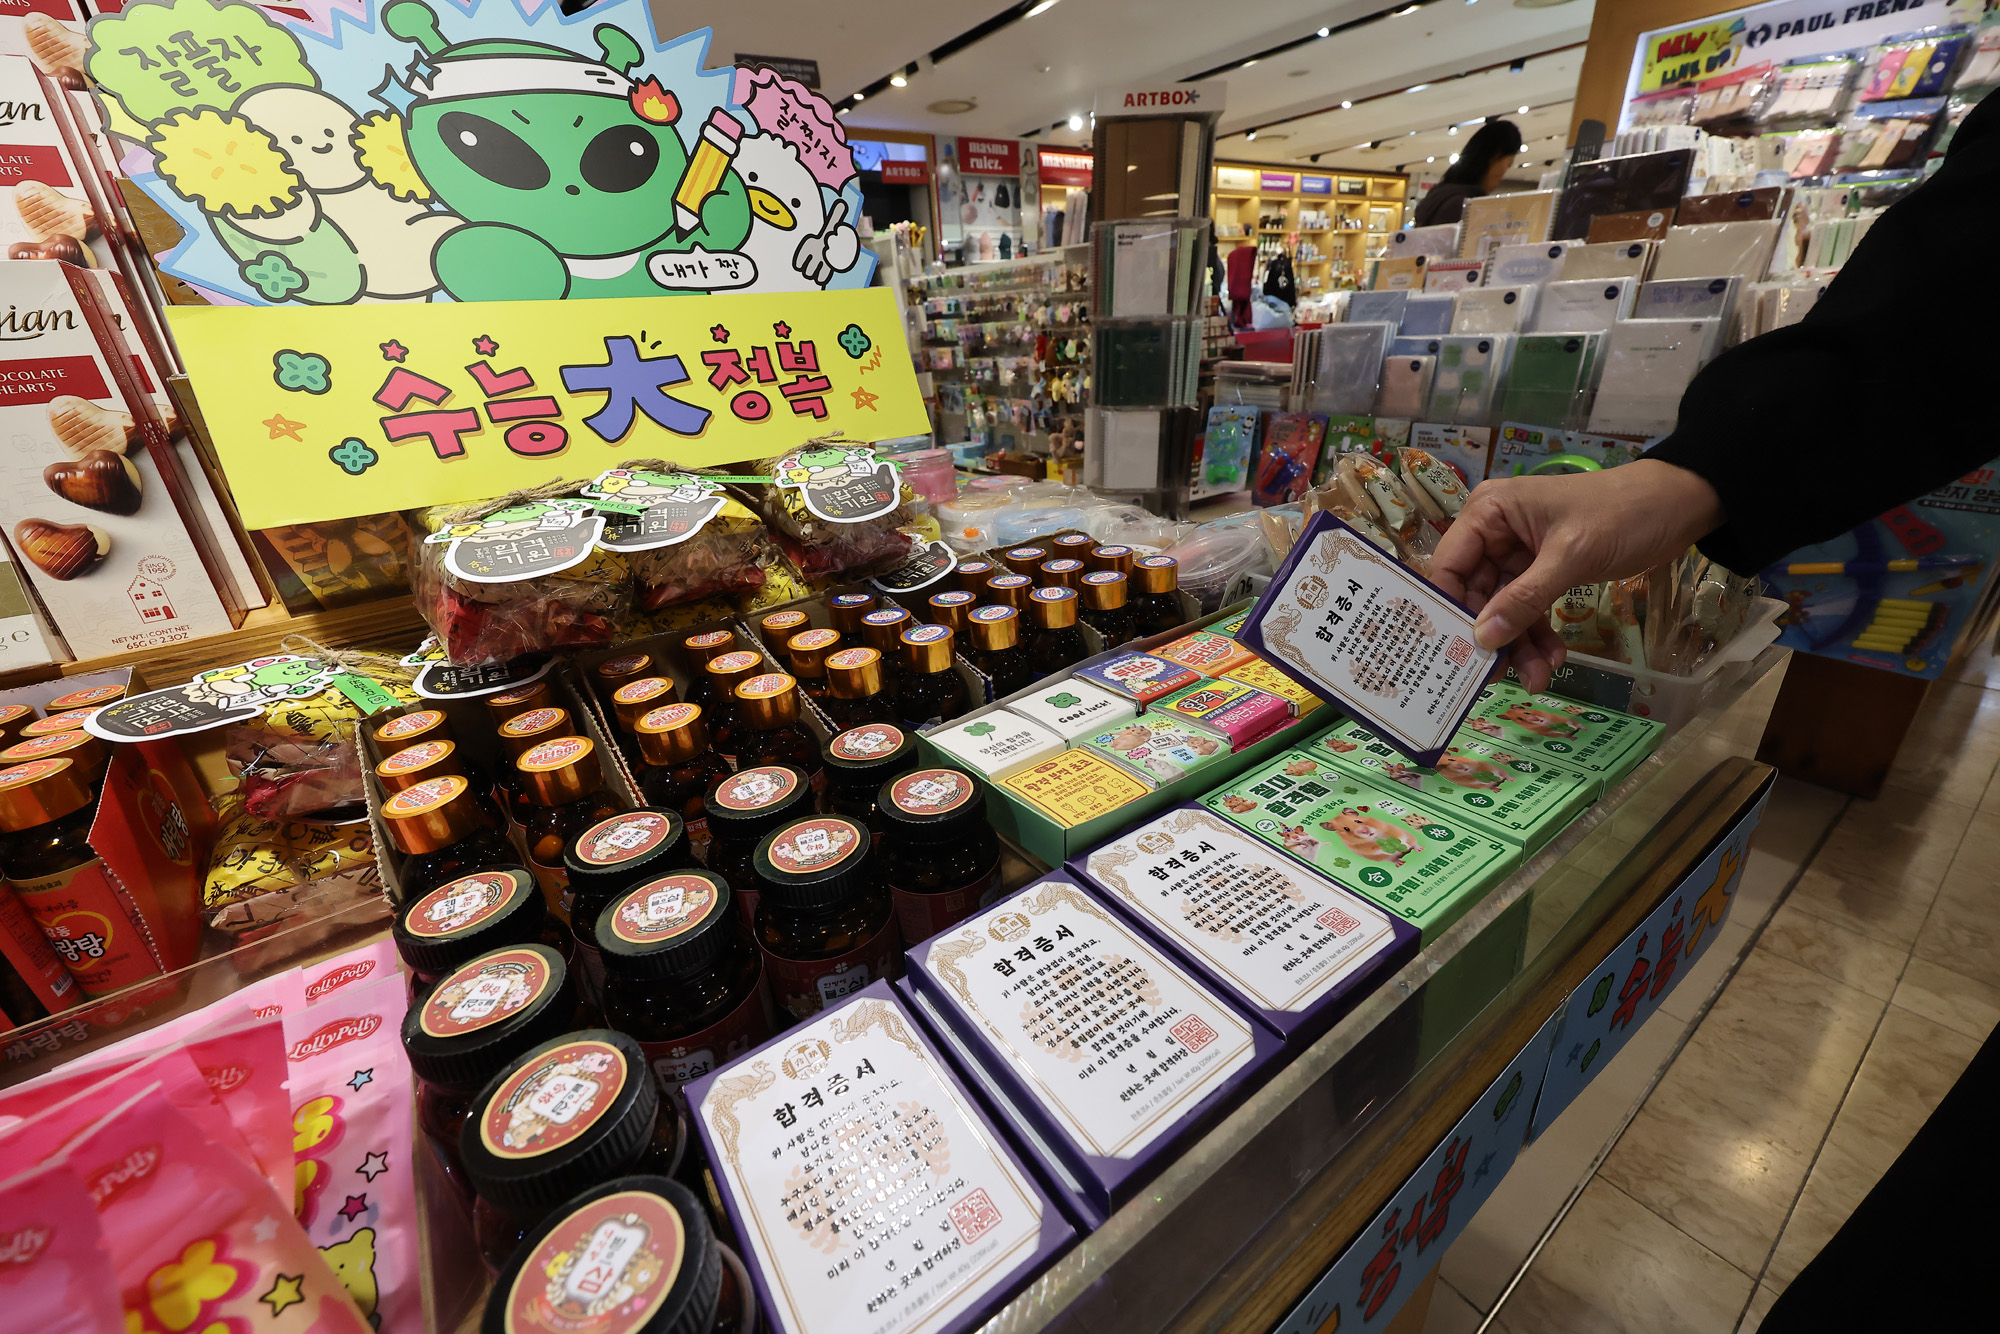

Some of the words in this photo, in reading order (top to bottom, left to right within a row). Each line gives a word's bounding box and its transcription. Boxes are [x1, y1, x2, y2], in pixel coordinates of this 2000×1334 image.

[1775, 12, 1836, 39] PAUL
[118, 29, 262, 97] 잘풀자
[1657, 28, 1708, 63] NEW
[1124, 90, 1196, 107] ARTBOX
[776, 97, 838, 170] 잘찍자
[969, 142, 1009, 156] masma
[662, 260, 709, 279] 내가
[715, 258, 740, 280] 짱
[147, 567, 168, 575] 1956
[1315, 578, 1363, 642] 합격증서
[111, 636, 128, 645] NET
[127, 641, 147, 650] 65G
[1058, 709, 1087, 724] Good
[1084, 700, 1112, 713] luck!
[1177, 690, 1226, 712] 합격
[979, 740, 1007, 755] 당신의
[1005, 730, 1032, 743] 합격을
[1023, 777, 1052, 792] 합격
[1048, 767, 1073, 781] 부적
[1069, 759, 1094, 772] 초코
[1249, 774, 1297, 800] 절대
[1264, 780, 1331, 819] 합격햄
[1492, 799, 1522, 819] 합격햄!
[1148, 840, 1216, 880] 합격증서
[1170, 878, 1188, 891] 사람은
[1188, 864, 1213, 880] 밤낮없이
[1212, 852, 1240, 865] 공부하고,
[1183, 882, 1203, 895] 남다른
[1203, 870, 1222, 883] 노력과
[1221, 863, 1238, 872] 집념,
[1368, 872, 1385, 883] 合
[1385, 876, 1424, 903] 합격햄!
[1417, 854, 1454, 878] 축하햄!
[1183, 902, 1210, 920] 누구보다
[1210, 890, 1230, 904] 뛰어난
[1230, 880, 1249, 892] 실력을
[1190, 889, 1211, 903] 뜨거운
[1210, 877, 1230, 890] 열정과
[1229, 868, 1249, 879] 열의로
[1193, 913, 1215, 928] 매시간
[1214, 900, 1235, 915] 노력과
[1234, 889, 1254, 902] 최선을
[1252, 872, 1282, 890] 다했습니다.
[654, 905, 675, 916] 合格
[1208, 913, 1236, 932] 평소보다
[1243, 900, 1258, 910] 높은
[1256, 888, 1278, 901] 점수를
[1275, 880, 1290, 890] 받아
[1229, 914, 1257, 933] 틀림없이
[1255, 903, 1276, 916] 원하는
[1274, 893, 1290, 904] 곳에
[1249, 920, 1271, 935] 합격할
[1269, 904, 1295, 922] 것이기에
[1242, 944, 1258, 955] 미리
[1264, 921, 1292, 940] 합격증을
[1291, 902, 1321, 922] 수여합니다.
[992, 924, 1074, 977] 합격증서
[1013, 974, 1035, 990] 사람은
[1036, 955, 1066, 976] 밤낮없이
[1067, 938, 1100, 957] 공부하고,
[1282, 957, 1302, 971] 원하는
[1299, 947, 1315, 959] 곳에
[1312, 932, 1336, 949] 합격하장
[1026, 979, 1050, 996] 남다른
[1052, 964, 1075, 980] 노력과
[1075, 954, 1094, 966] 집념,
[1033, 989, 1058, 1007] 뜨거운
[1058, 973, 1082, 990] 열정과
[1082, 960, 1105, 975] 열의로
[1023, 1006, 1053, 1029] 누구보다
[1054, 990, 1079, 1008] 뛰어난
[1080, 976, 1102, 992] 실력을
[1078, 1064, 1096, 1079] 미리
[1097, 1056, 1107, 1065] 이
[1107, 1033, 1140, 1058] 합격증을
[1141, 1007, 1181, 1034] 수여합니다.
[768, 1054, 878, 1133] 합격증서
